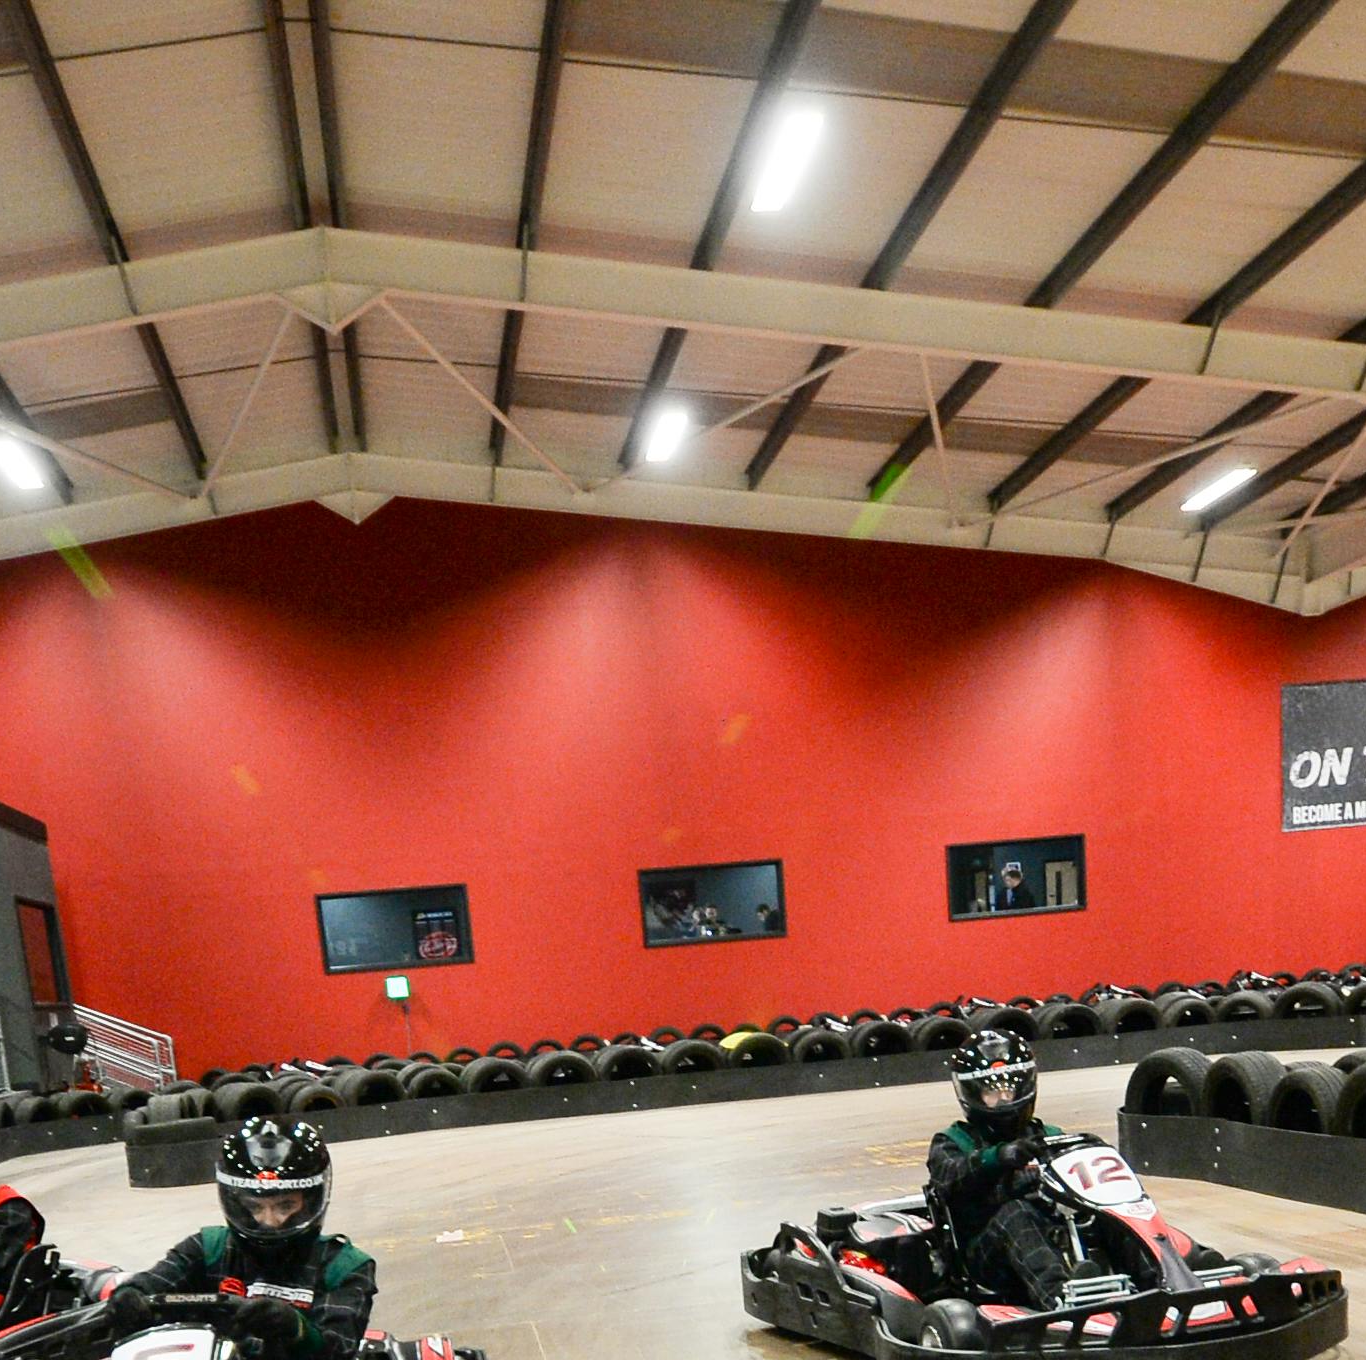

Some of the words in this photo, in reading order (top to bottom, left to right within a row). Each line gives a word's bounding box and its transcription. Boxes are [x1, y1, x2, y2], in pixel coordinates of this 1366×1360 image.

[1289, 747, 1353, 788] ON
[1292, 803, 1343, 825] BECOME
[1343, 803, 1354, 820] A
[1068, 1156, 1132, 1190] 12
